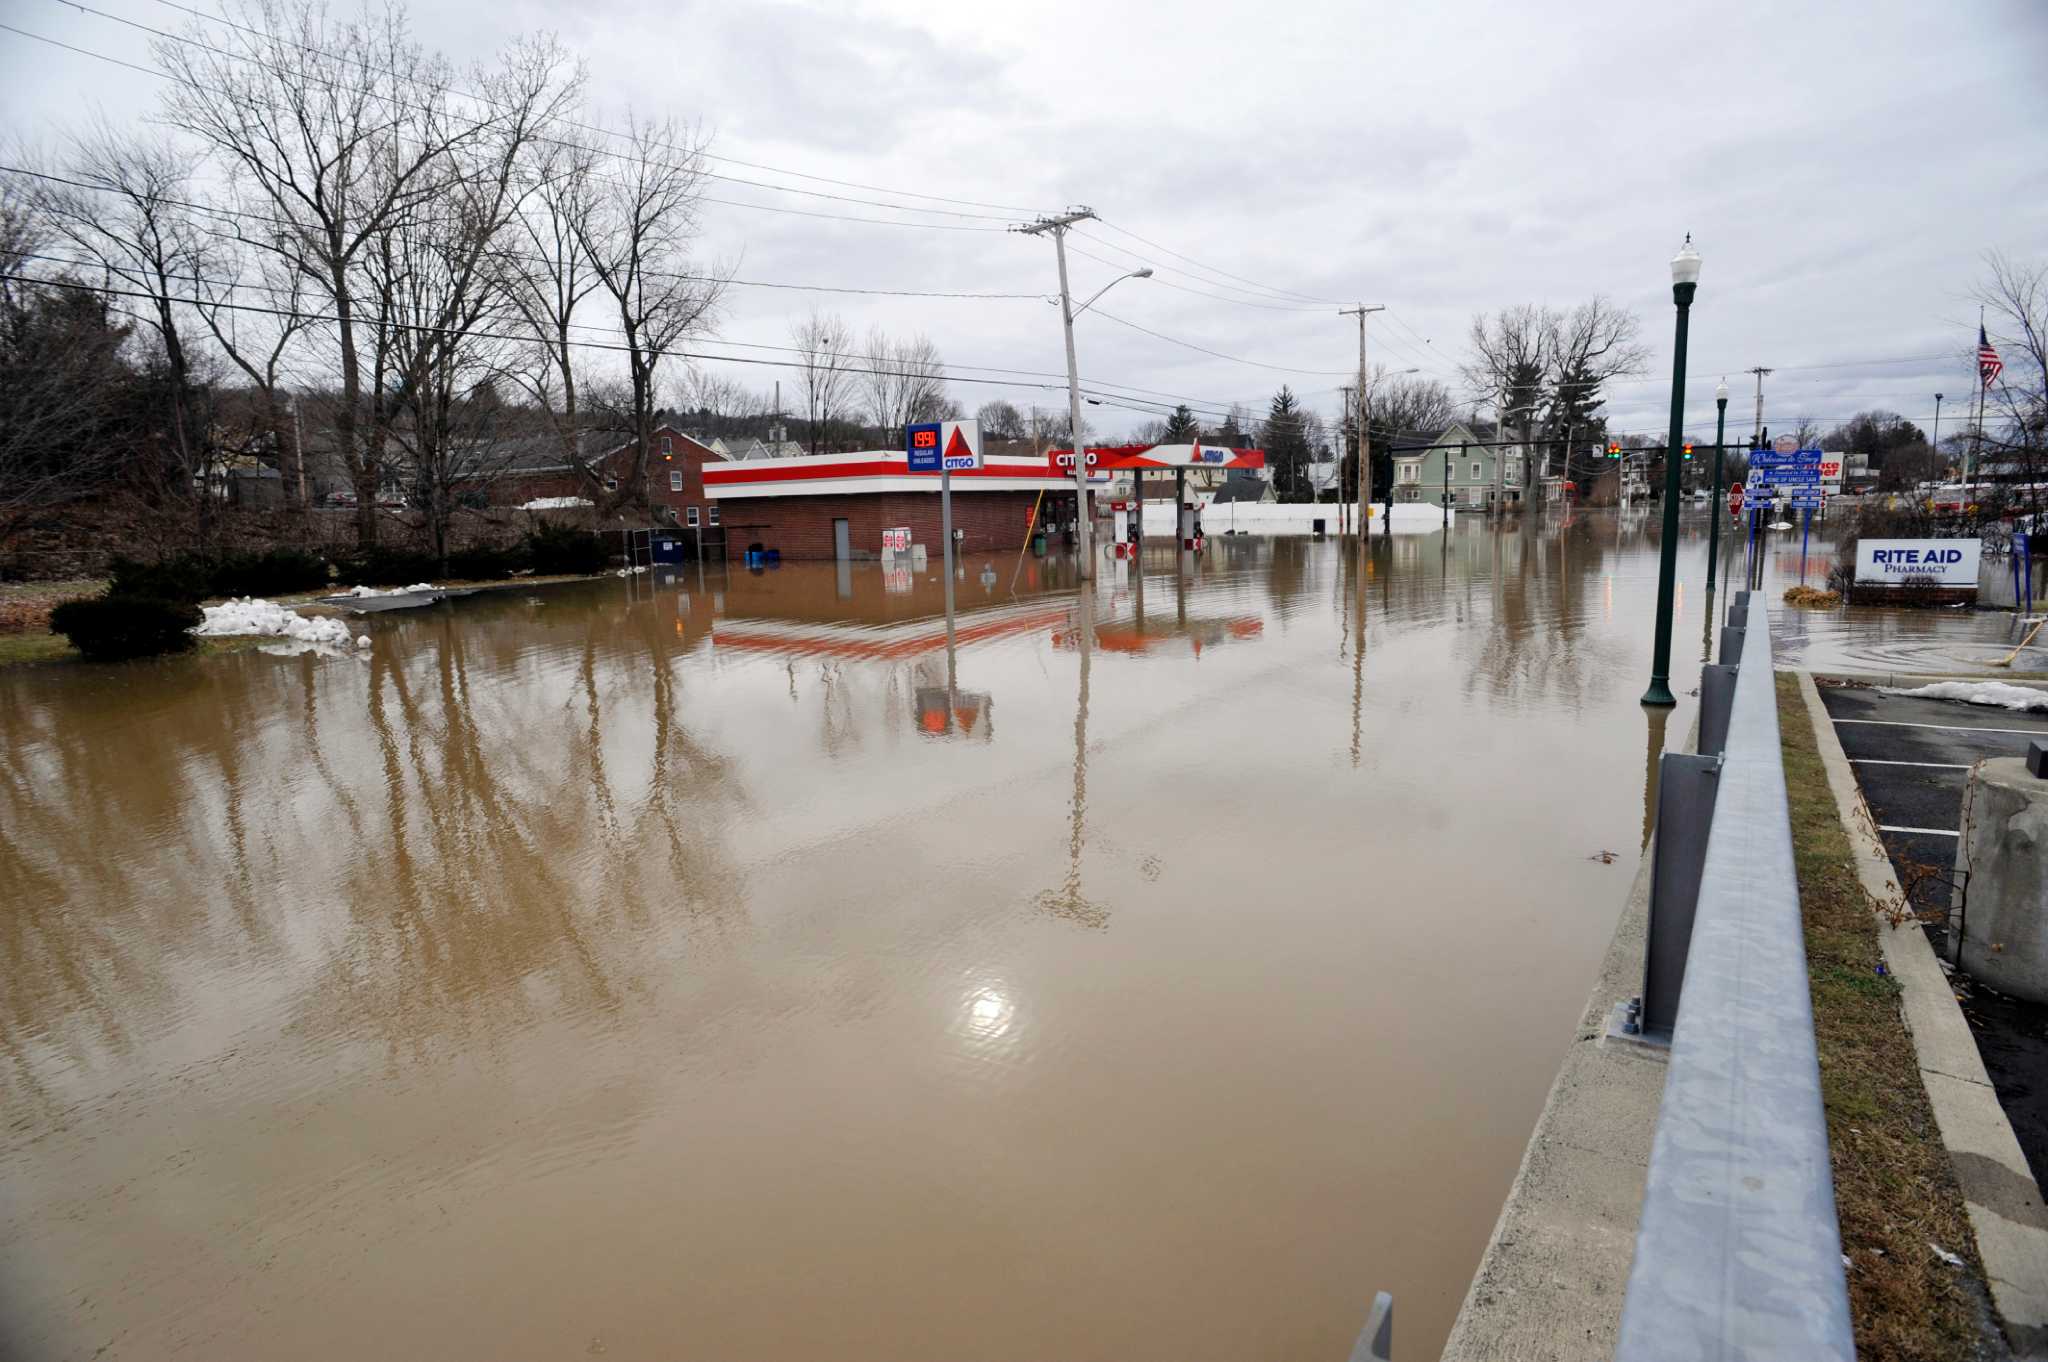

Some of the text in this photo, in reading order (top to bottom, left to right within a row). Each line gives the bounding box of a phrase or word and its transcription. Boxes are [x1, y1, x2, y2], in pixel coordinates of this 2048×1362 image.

[946, 458, 974, 468] CITGO
[1056, 452, 1097, 467] CITO
[1731, 493, 1744, 505] STOP
[1873, 549, 1962, 563] RITE AID
